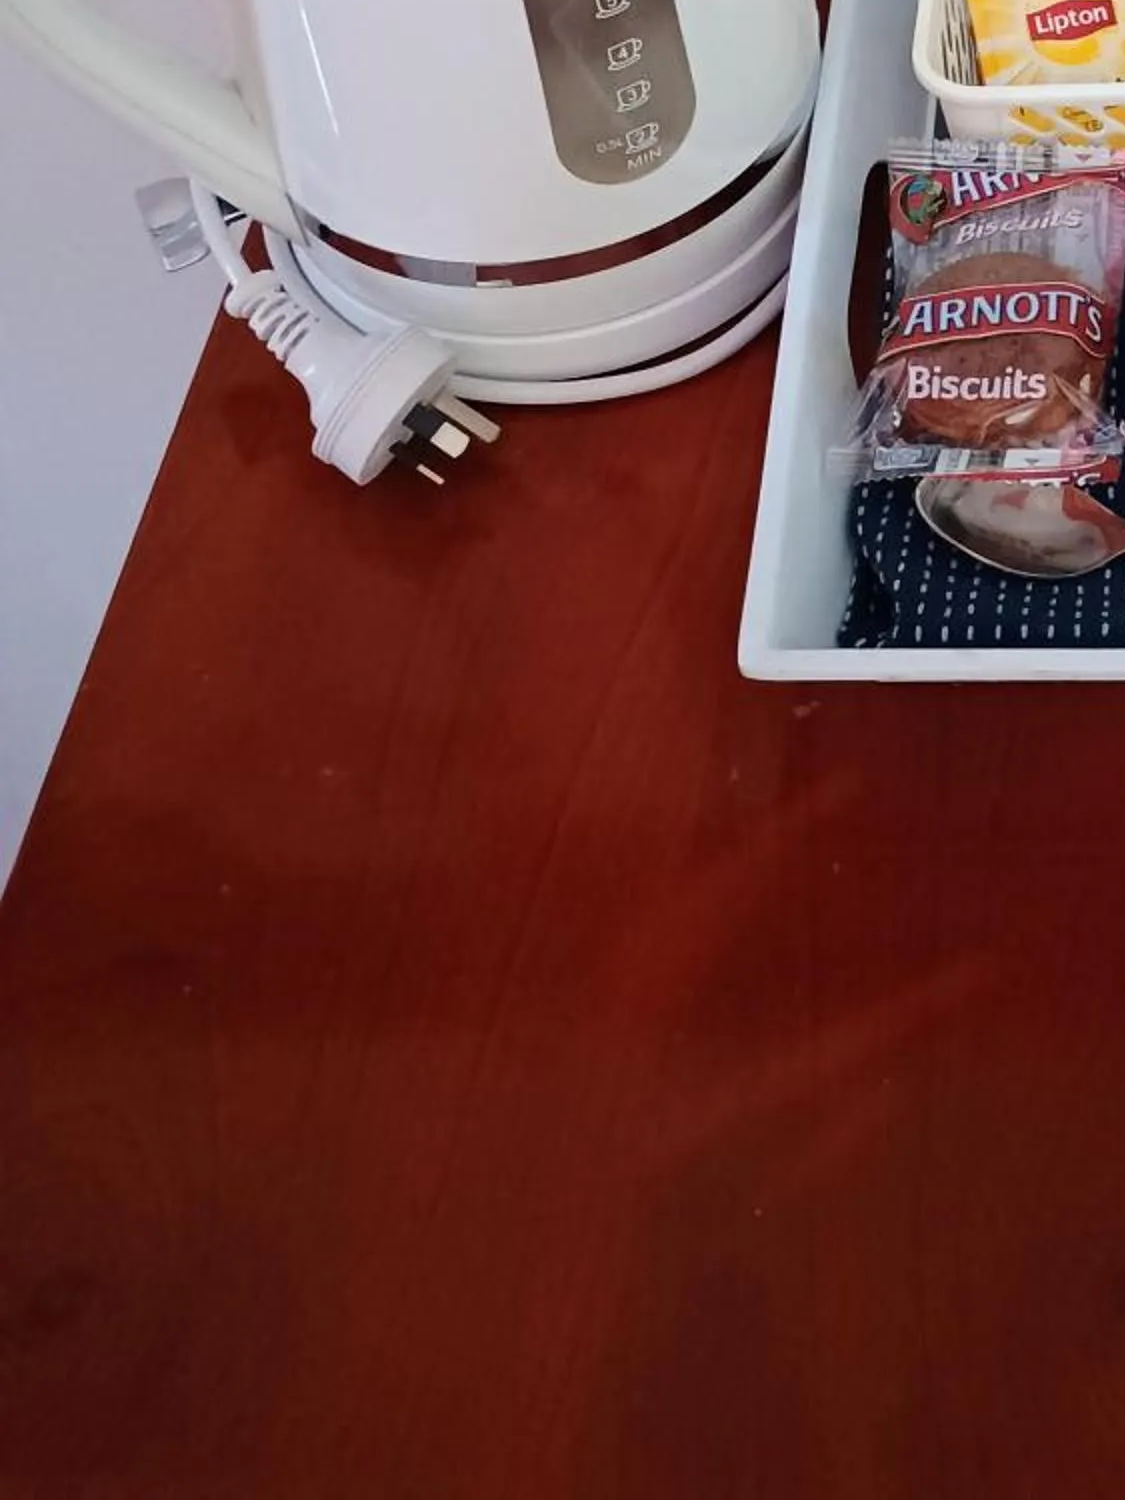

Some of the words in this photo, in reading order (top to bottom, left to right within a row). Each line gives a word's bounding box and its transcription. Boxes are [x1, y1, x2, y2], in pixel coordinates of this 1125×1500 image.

[1034, 4, 1109, 35] Lipton
[626, 145, 662, 170] MIN
[956, 209, 1083, 245] Biscuits
[904, 290, 1103, 342] ARNOTT'S
[907, 363, 1048, 401] Biscuits
